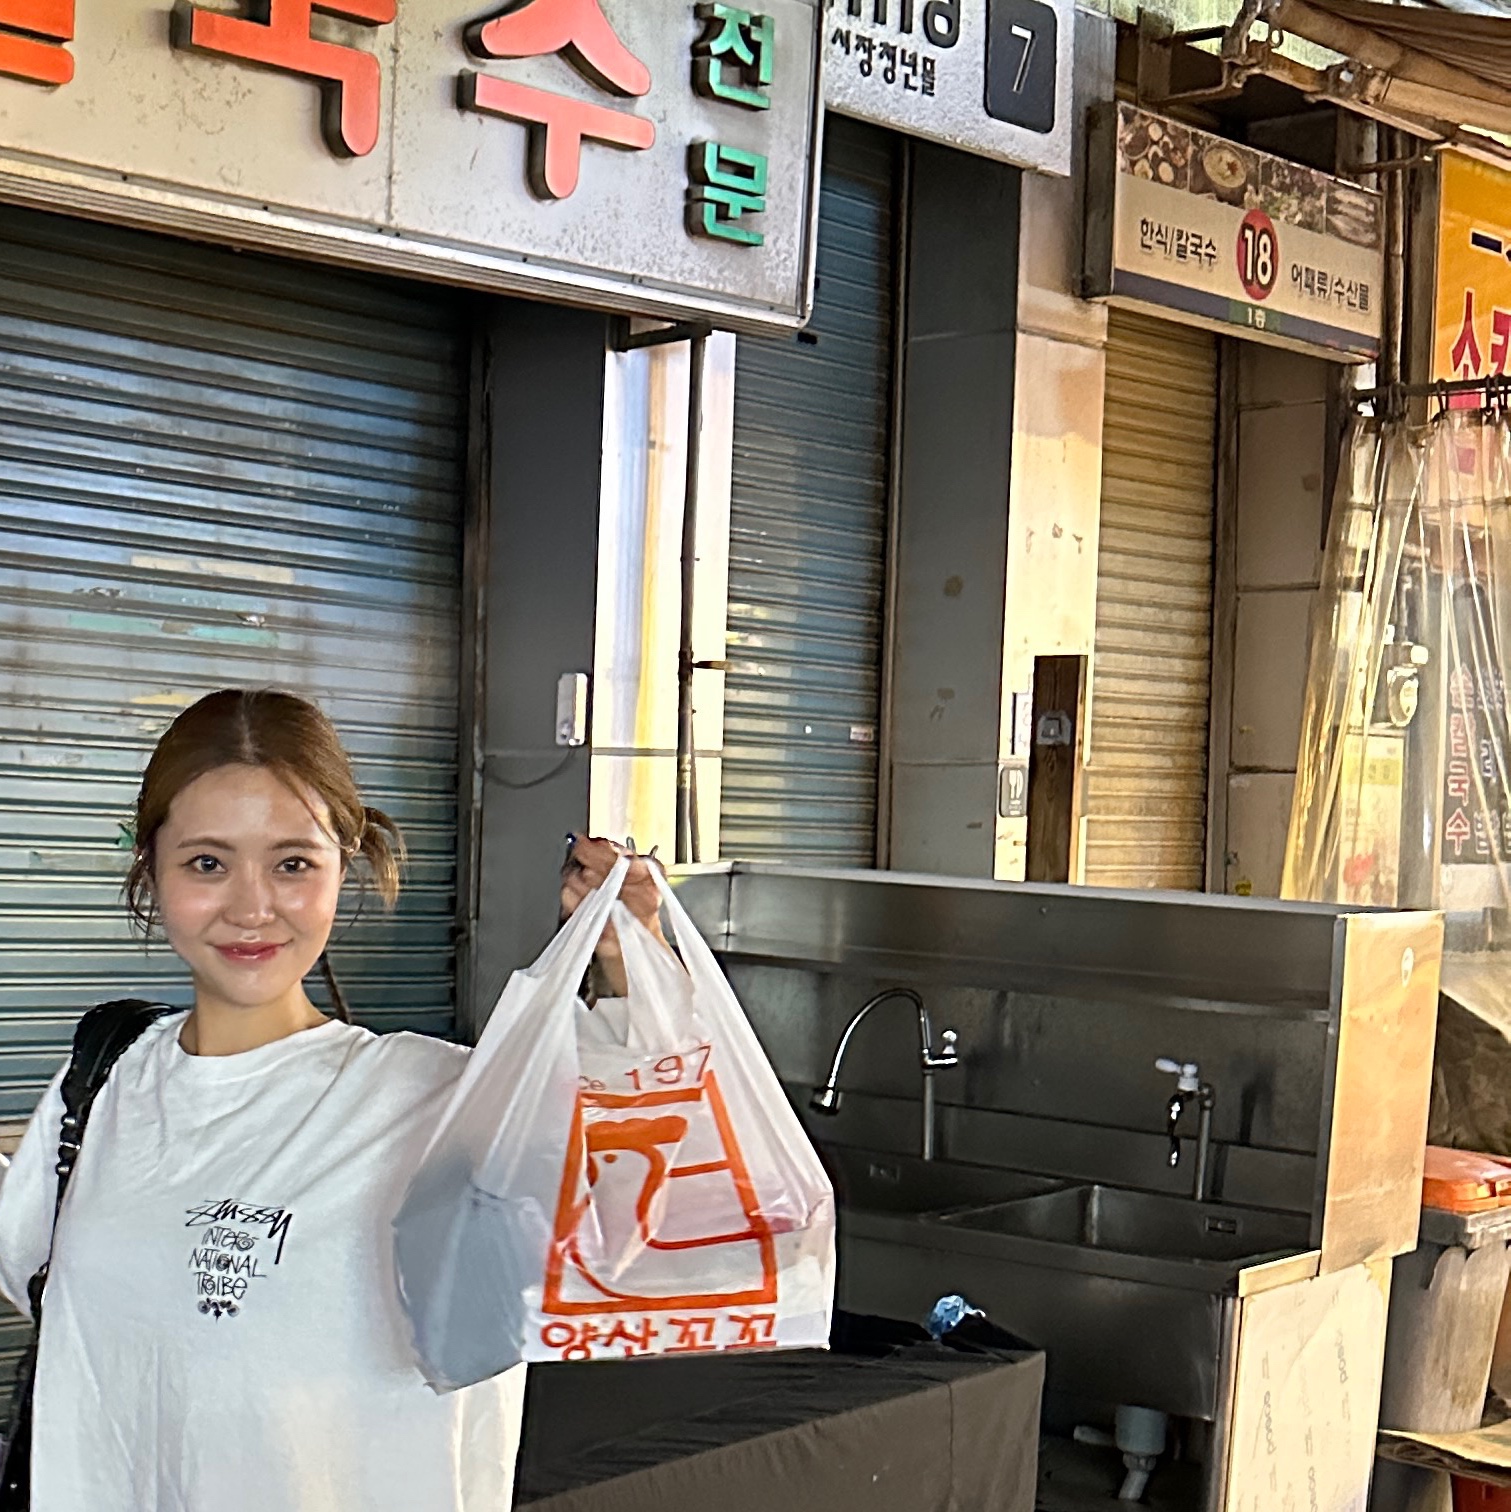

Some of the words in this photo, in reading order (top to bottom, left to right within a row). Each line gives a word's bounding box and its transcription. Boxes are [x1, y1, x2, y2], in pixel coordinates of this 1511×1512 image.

[1010, 24, 1036, 93] 7
[1140, 217, 1217, 267] 한식/칼국수
[1242, 227, 1275, 291] 18
[189, 1247, 267, 1278] NATIONAL
